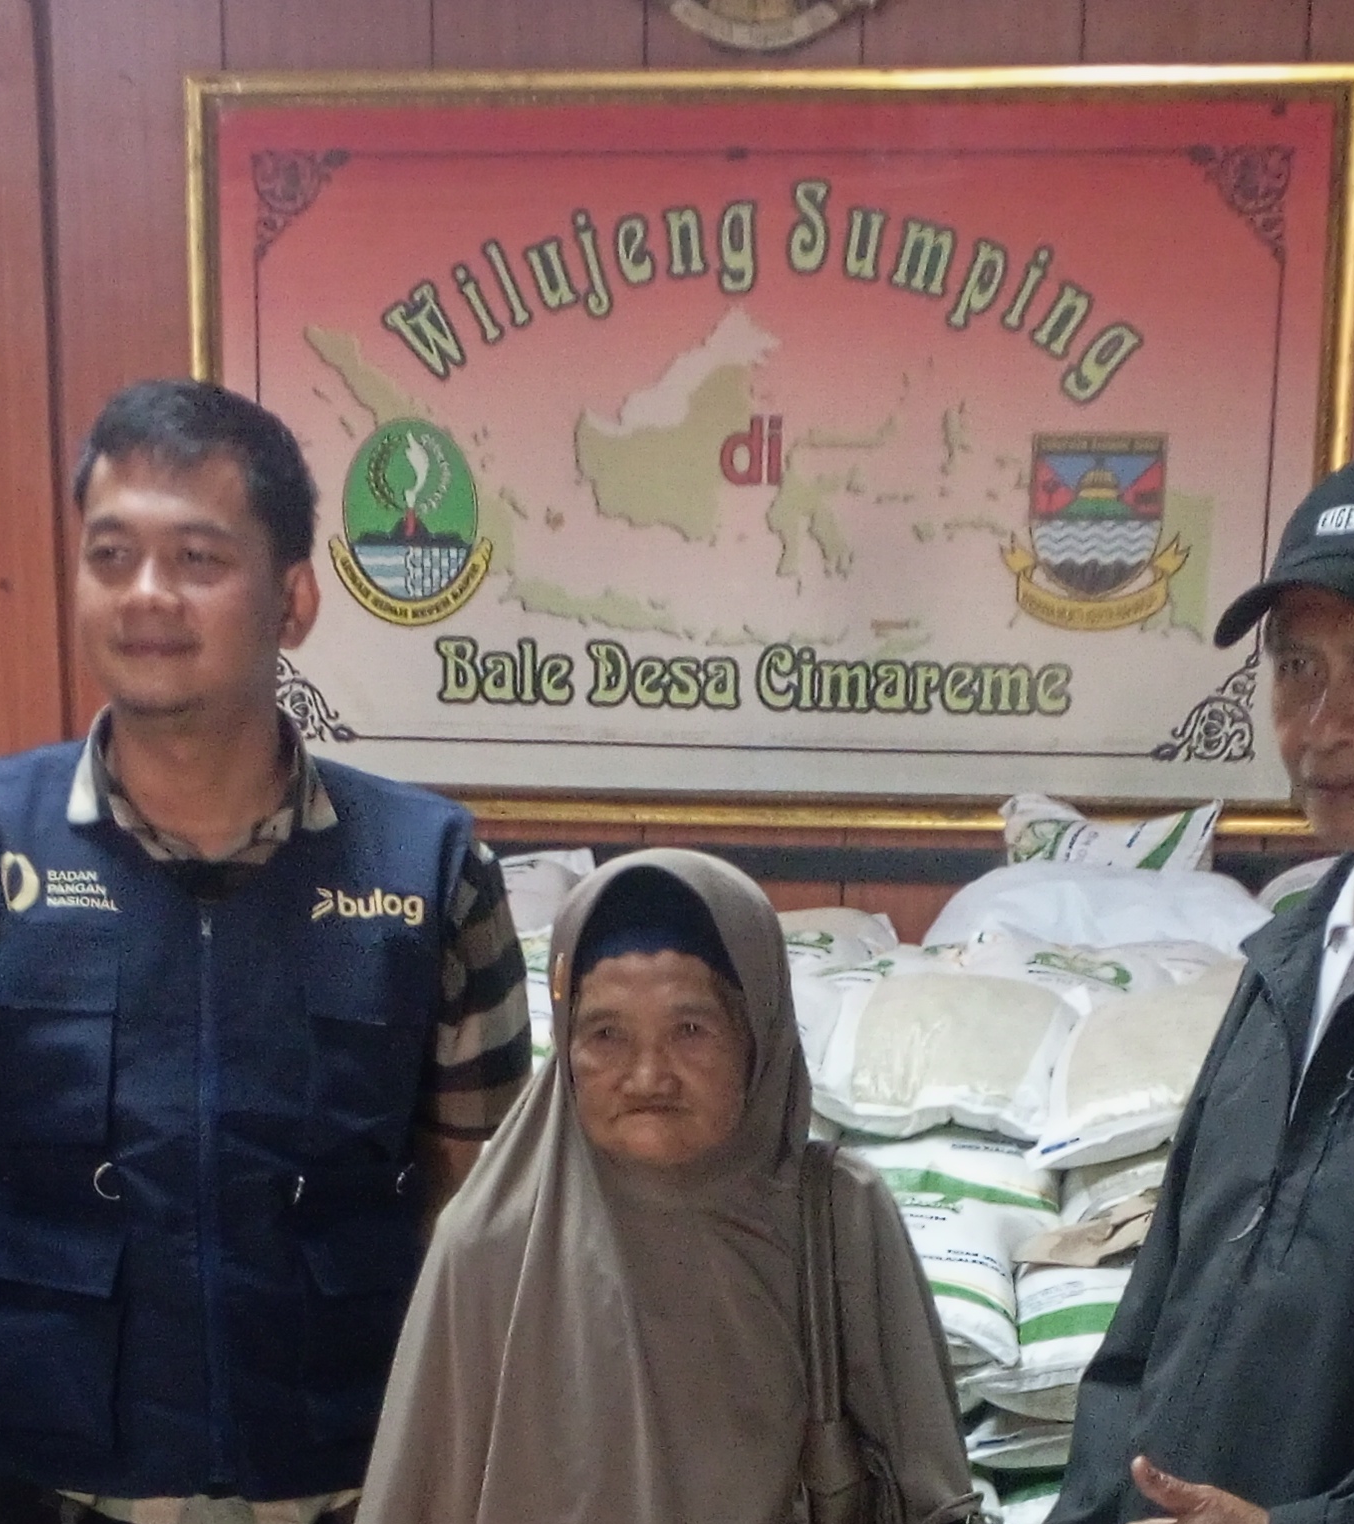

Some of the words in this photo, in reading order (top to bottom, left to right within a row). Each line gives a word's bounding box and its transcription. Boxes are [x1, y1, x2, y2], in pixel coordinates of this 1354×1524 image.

[381, 200, 756, 380] Wilujeng
[785, 176, 1142, 405] Sumping
[719, 415, 783, 485] di
[436, 635, 574, 705] Bale
[587, 639, 741, 708] Desa
[756, 642, 1072, 715] Cimareme
[47, 870, 97, 882] BADAN
[47, 883, 106, 896] PANGAN
[47, 896, 120, 912] NASIONAL
[338, 888, 425, 926] bulog
